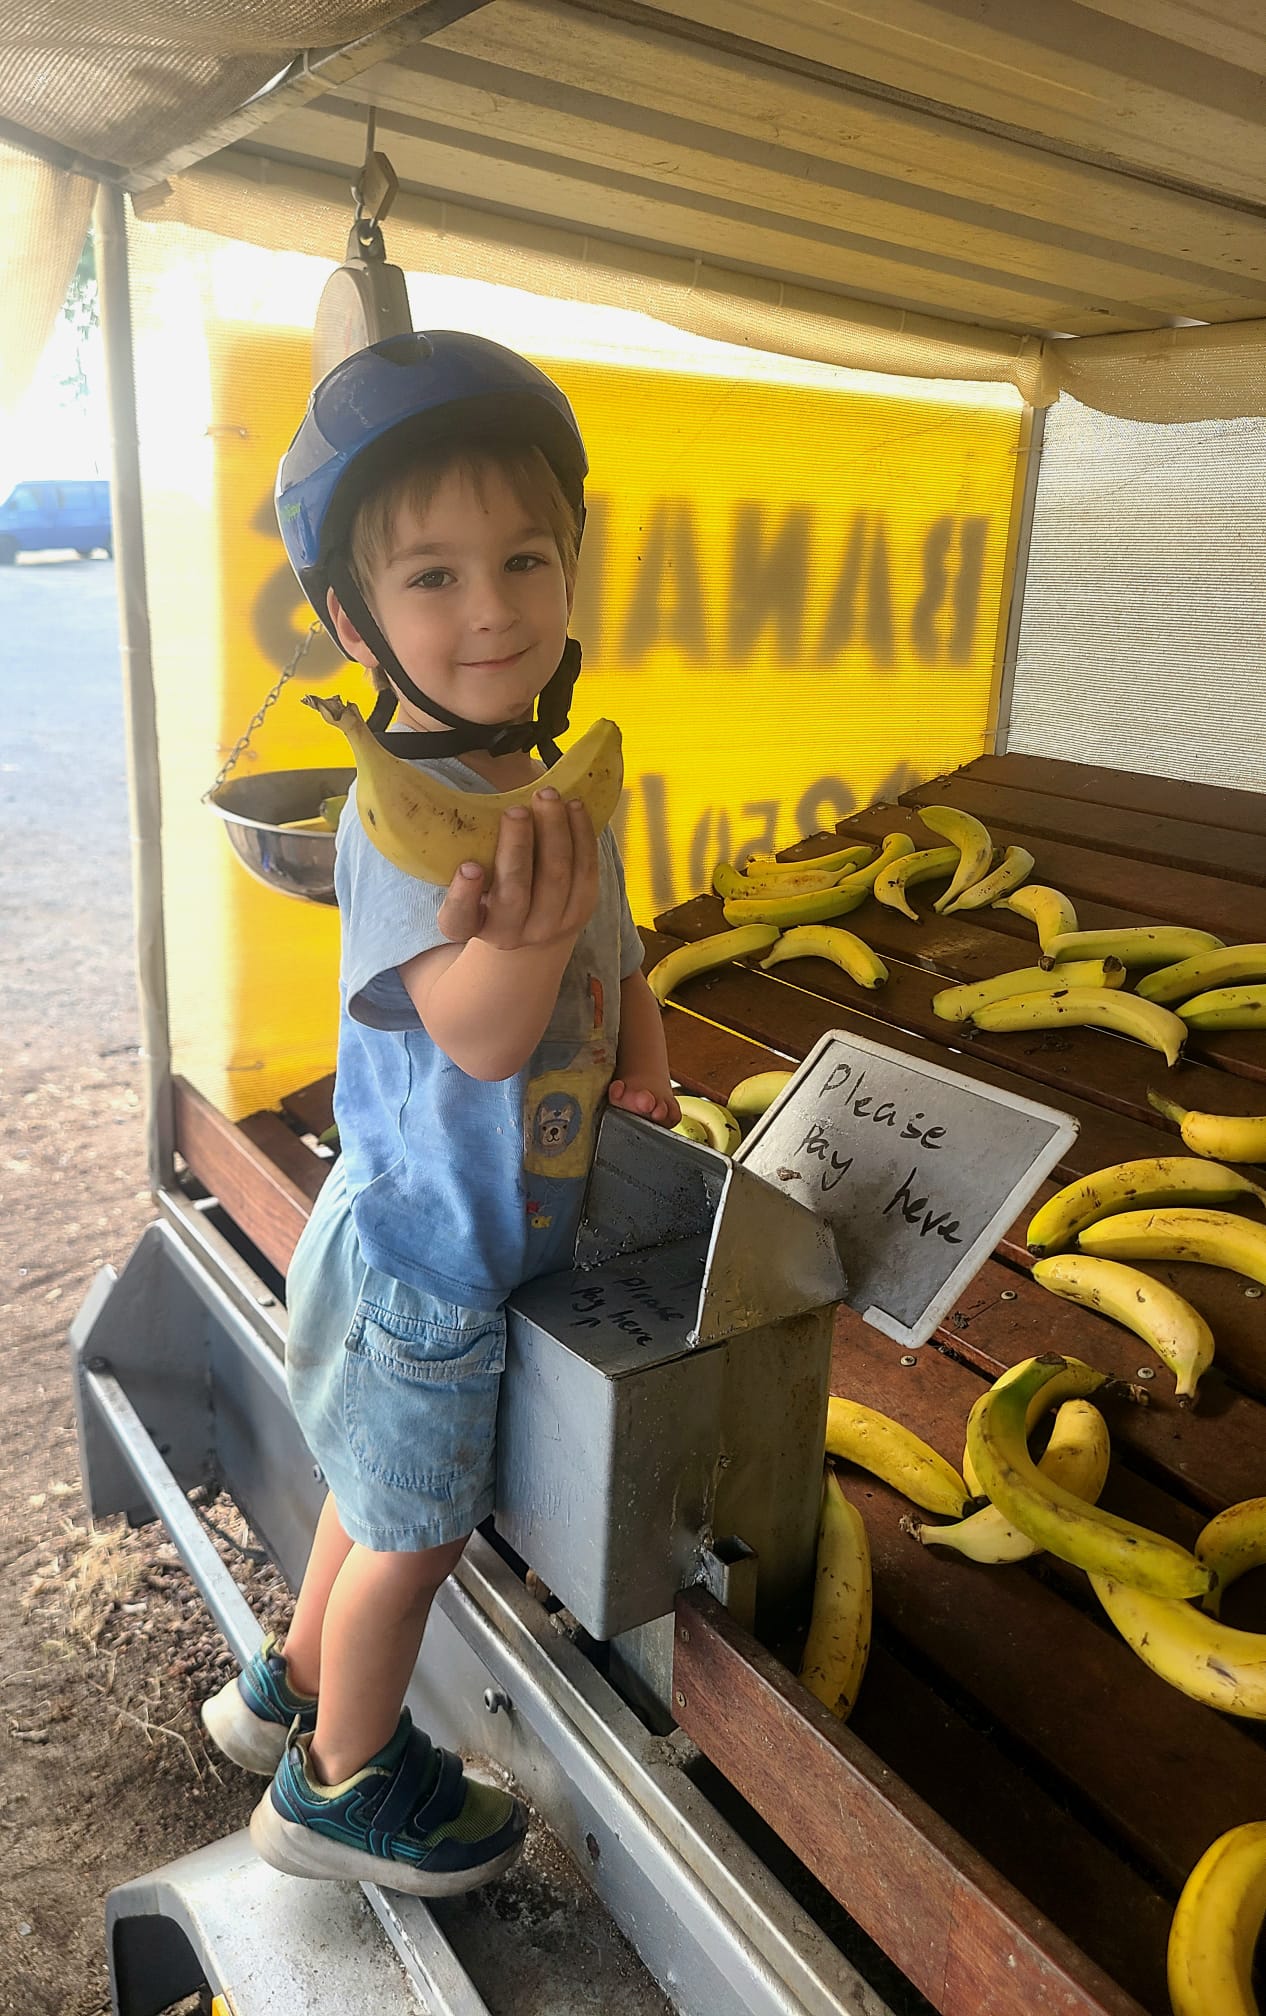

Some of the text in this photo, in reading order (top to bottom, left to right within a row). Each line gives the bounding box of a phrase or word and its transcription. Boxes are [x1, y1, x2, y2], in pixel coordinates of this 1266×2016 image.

[819, 1063, 948, 1149] Please
[794, 1122, 963, 1243] Pay here
[608, 1310, 653, 1347] here
